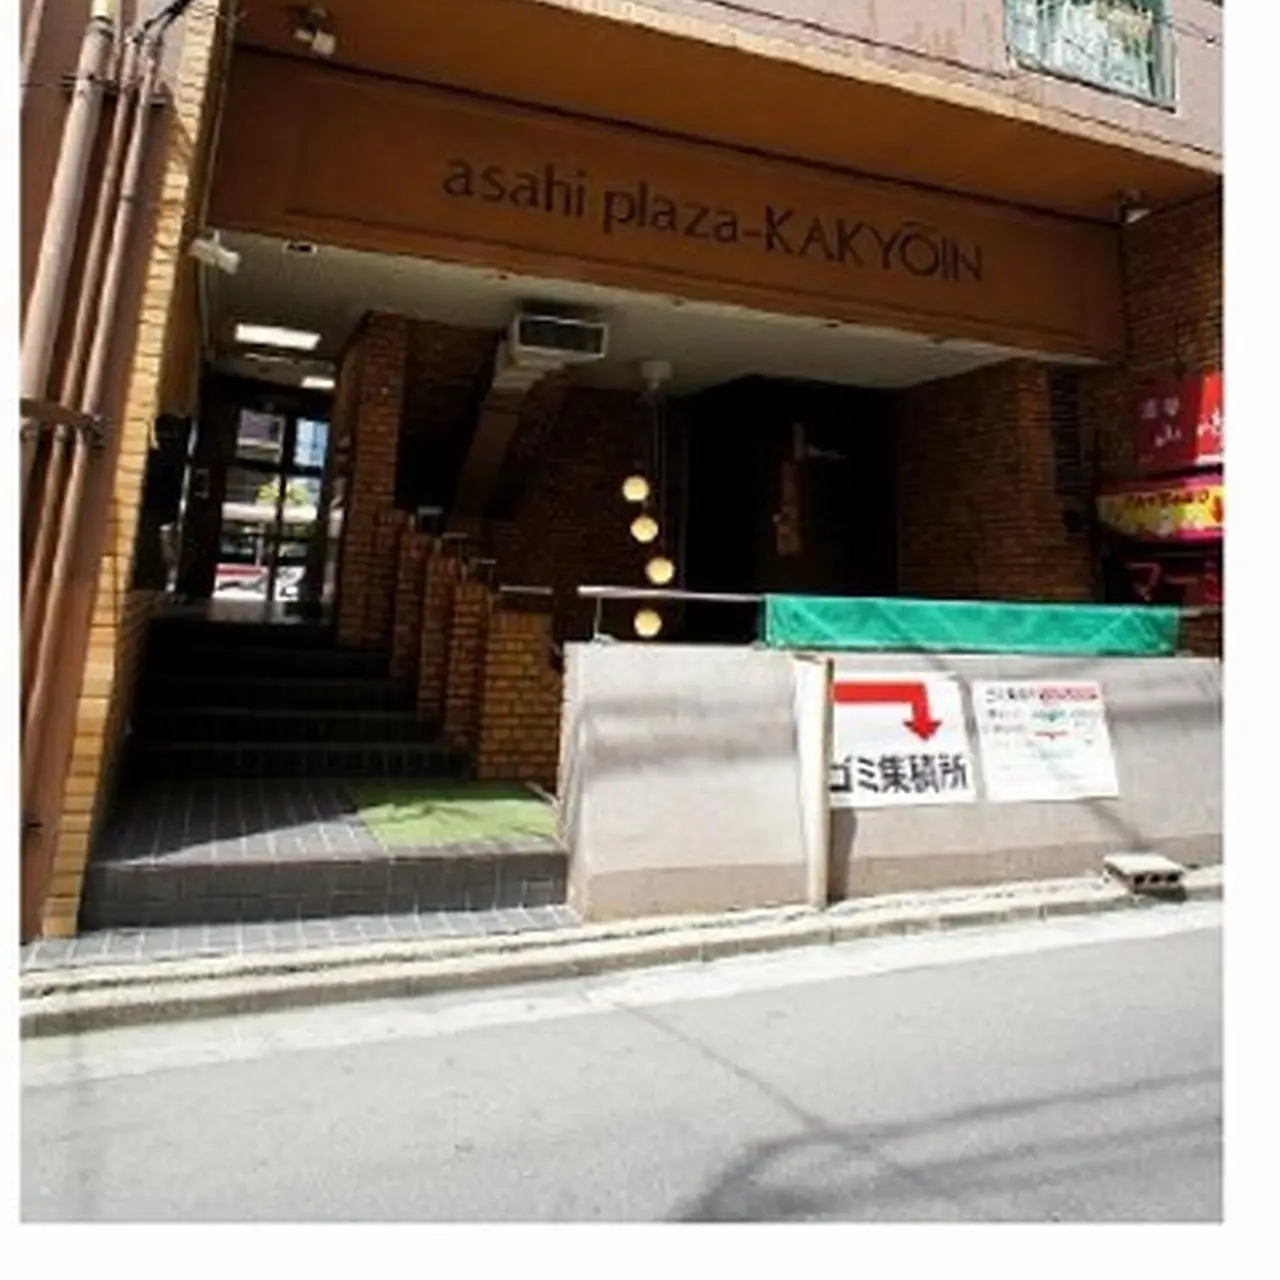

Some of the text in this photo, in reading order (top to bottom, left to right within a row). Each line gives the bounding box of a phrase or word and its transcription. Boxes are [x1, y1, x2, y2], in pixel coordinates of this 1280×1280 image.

[442, 157, 587, 219] asahi
[830, 754, 968, 794] ゴミ集積所
